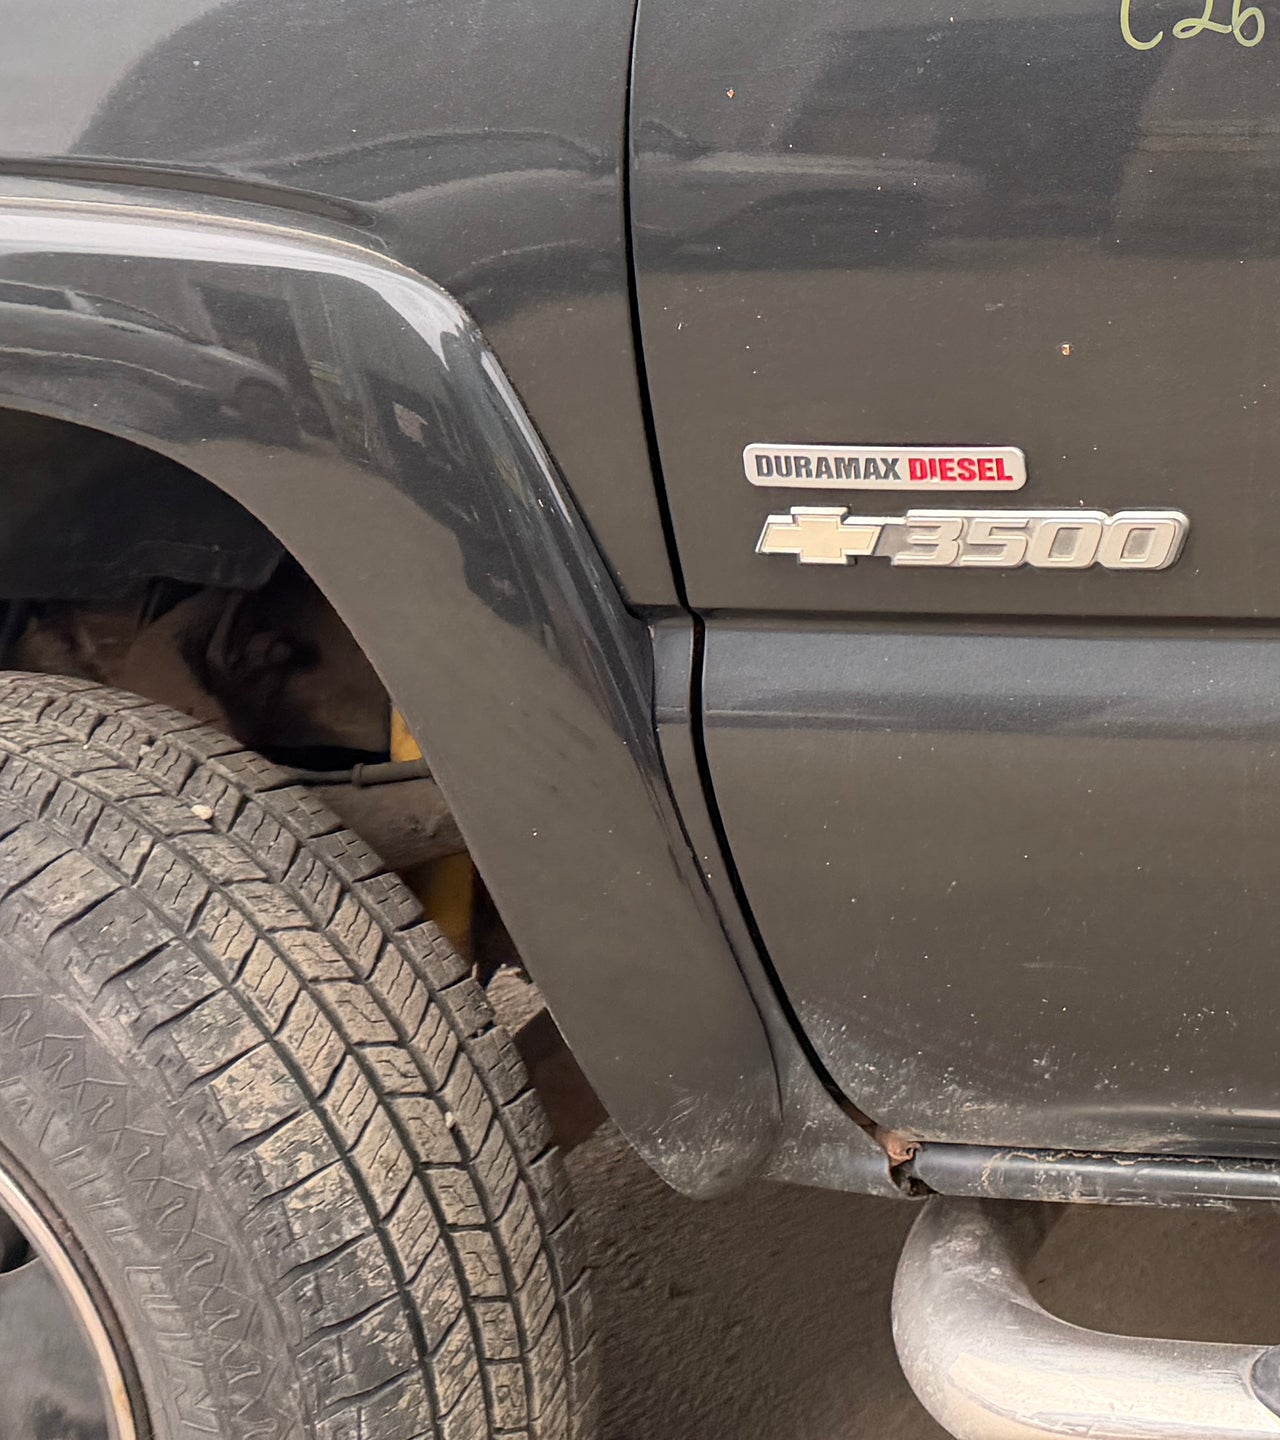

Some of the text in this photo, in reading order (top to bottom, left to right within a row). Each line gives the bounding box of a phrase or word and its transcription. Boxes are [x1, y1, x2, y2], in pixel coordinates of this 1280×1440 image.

[754, 454, 1014, 482] DURAMAX DIESEL
[893, 513, 1186, 569] 3500
